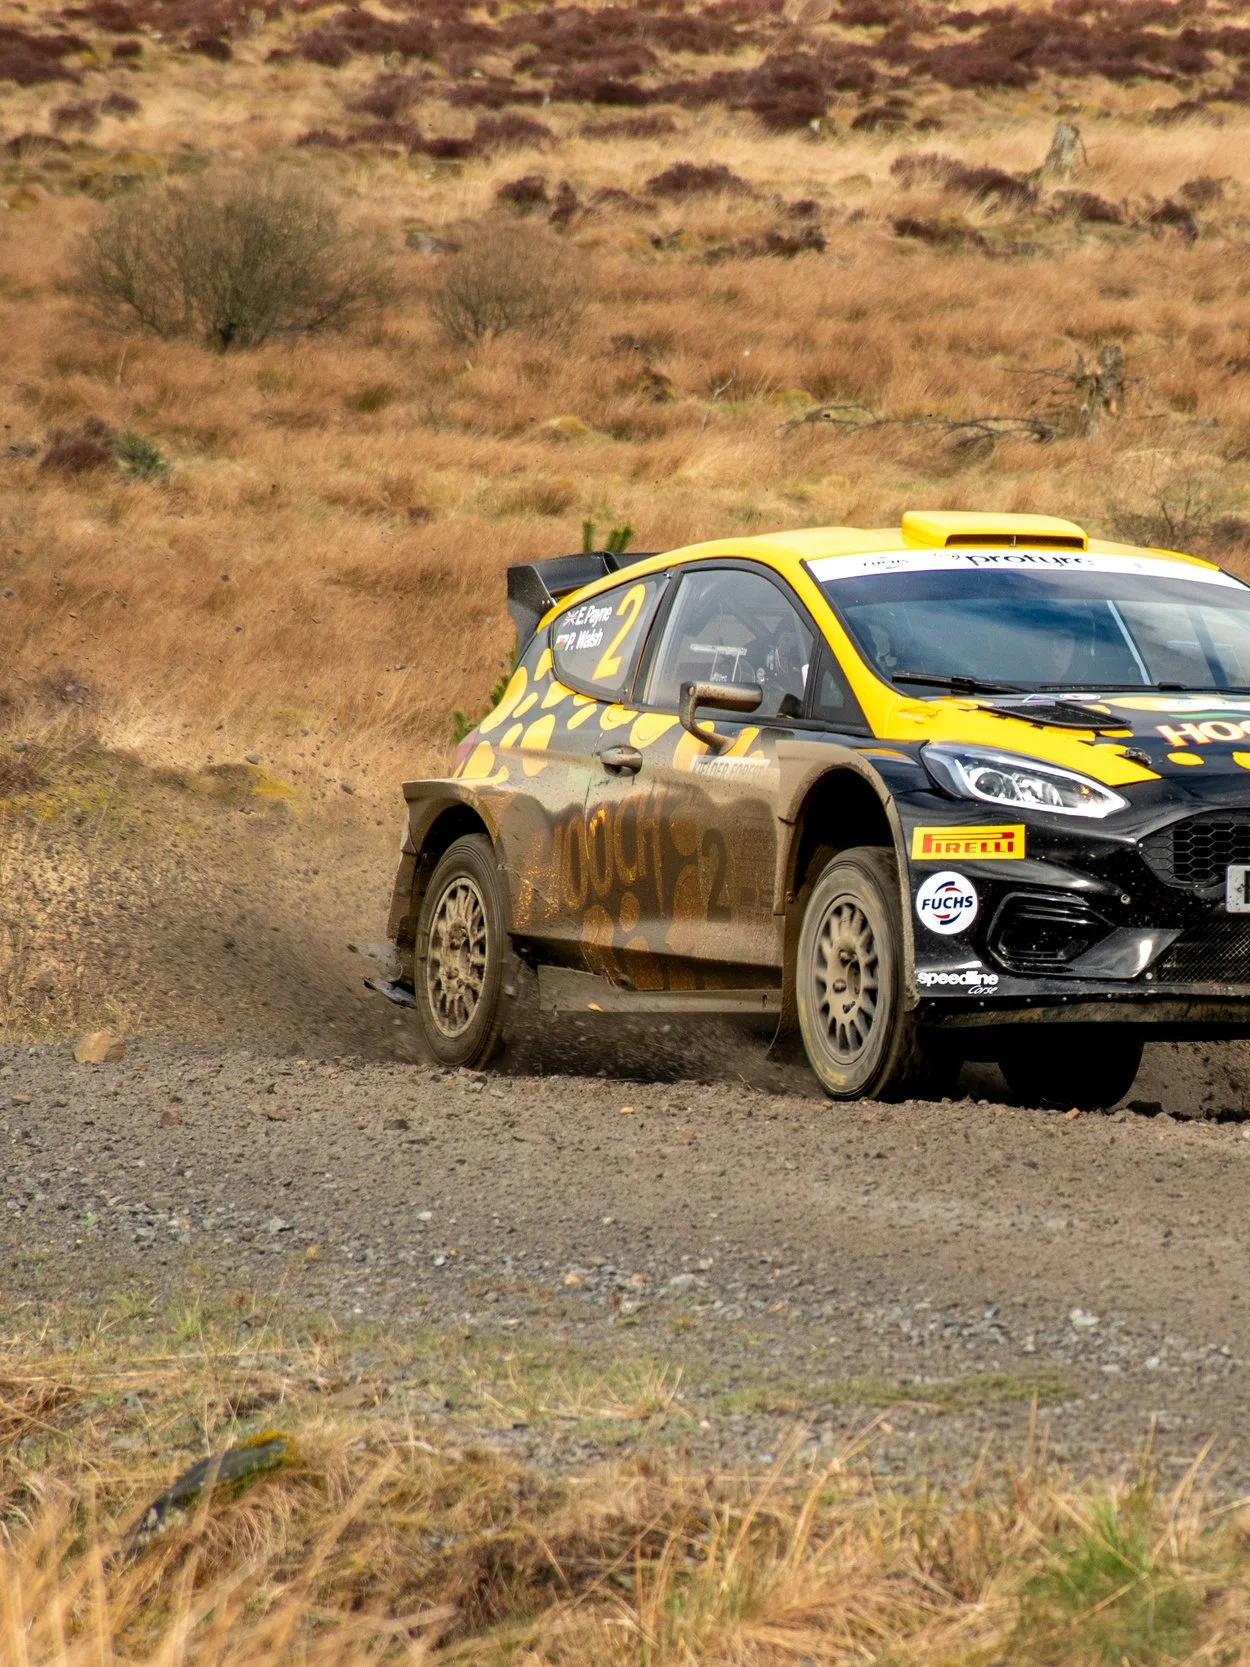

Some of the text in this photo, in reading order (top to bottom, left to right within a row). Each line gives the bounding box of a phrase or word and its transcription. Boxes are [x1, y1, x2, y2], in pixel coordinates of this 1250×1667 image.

[565, 628, 604, 651] P. Walsh
[592, 583, 646, 681] 2
[922, 832, 1015, 854] PIRELLI
[921, 896, 974, 910] FUCHS
[917, 971, 998, 987] speedline
[967, 985, 999, 995] Corse
